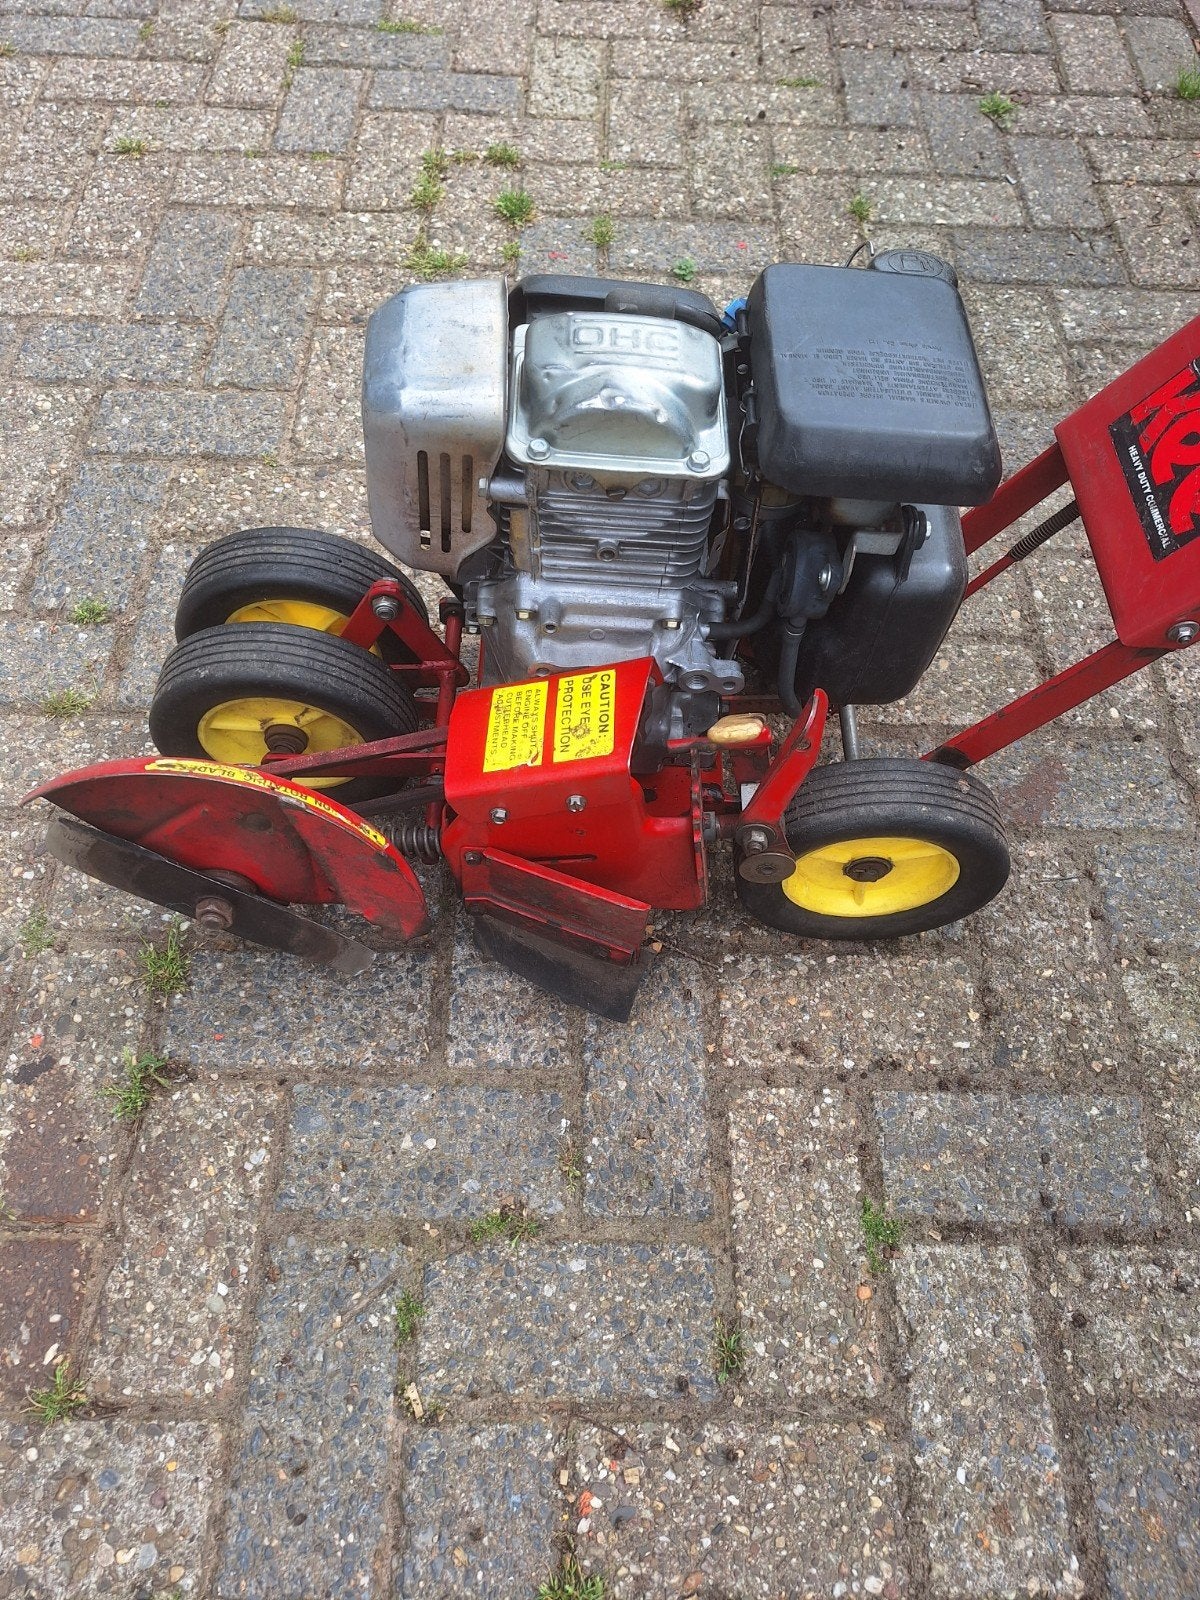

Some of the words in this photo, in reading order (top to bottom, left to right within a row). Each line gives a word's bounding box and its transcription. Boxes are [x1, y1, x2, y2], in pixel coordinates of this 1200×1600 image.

[572, 325, 679, 352] OHC
[1128, 445, 1143, 472] HEAVY
[1137, 471, 1152, 494] DUTY
[1145, 494, 1170, 549] COMMERCIAL
[581, 676, 593, 699] USE
[512, 691, 523, 725] BEFORE
[522, 689, 533, 720] ENGINE
[530, 688, 541, 723] ALWAYS
[559, 679, 574, 753] PROTECTION
[580, 701, 591, 725] EYE
[598, 673, 611, 738] CAUTION:
[509, 726, 519, 761] MAKING
[521, 722, 529, 739] OFF
[529, 724, 538, 748] SHUT
